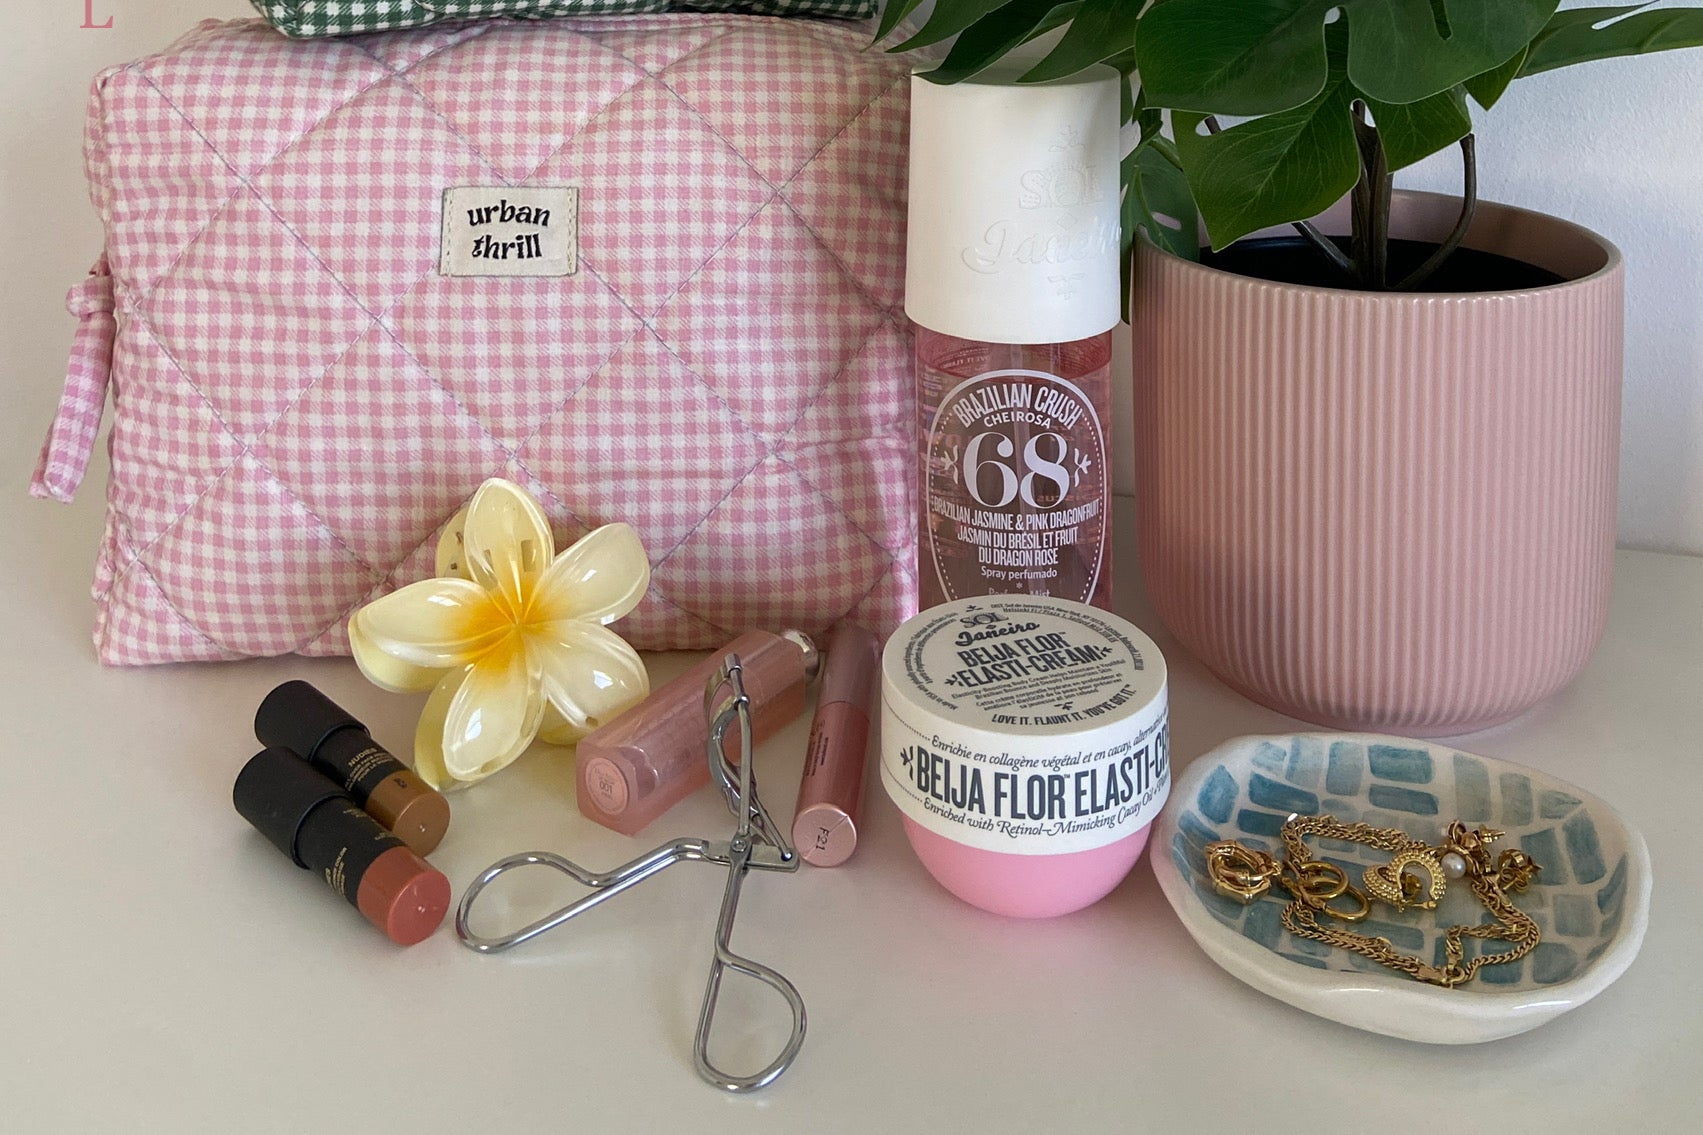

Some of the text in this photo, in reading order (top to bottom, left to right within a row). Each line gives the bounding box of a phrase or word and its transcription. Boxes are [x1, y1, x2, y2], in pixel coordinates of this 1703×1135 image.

[467, 199, 550, 226] urban
[472, 233, 542, 259] thrill
[953, 383, 1032, 428] BRAZILIAN
[1034, 386, 1083, 430] CRUSH
[983, 411, 1051, 429] CHEIROSA
[963, 432, 1070, 509] 68
[934, 496, 1100, 530] BRAZILIAN JASMINE & PINK DRAGONFRUIT
[958, 525, 1079, 549] JASMIN DU BRÉSIL ET FRUIT
[979, 547, 1059, 566] DU DRAGON ROSE
[981, 565, 1058, 580] Spray perfumado
[960, 612, 1009, 628] SOL
[955, 622, 1040, 646] Janeiro
[957, 643, 1021, 667] BEIJA
[957, 644, 1102, 687] ELASTI-CREAM
[992, 714, 1017, 725] LOVE
[1020, 716, 1032, 725] IT.
[1034, 714, 1072, 725] FLAUNT
[1071, 712, 1087, 722] IT.
[1082, 704, 1112, 718] YOU'VE
[1109, 691, 1129, 706] GOT
[931, 734, 972, 759] Enrichie
[973, 752, 986, 762] en
[989, 753, 1039, 772] collagène
[1041, 752, 1081, 772] végétal
[1082, 751, 1092, 764] et
[1094, 750, 1105, 760] en
[917, 745, 986, 815] BEIJA
[1075, 724, 1168, 818] ELASTI-CR
[924, 797, 966, 824] Enriched
[967, 817, 994, 832] with
[1117, 801, 1142, 824] Cacay
[1143, 787, 1155, 806] Oil
